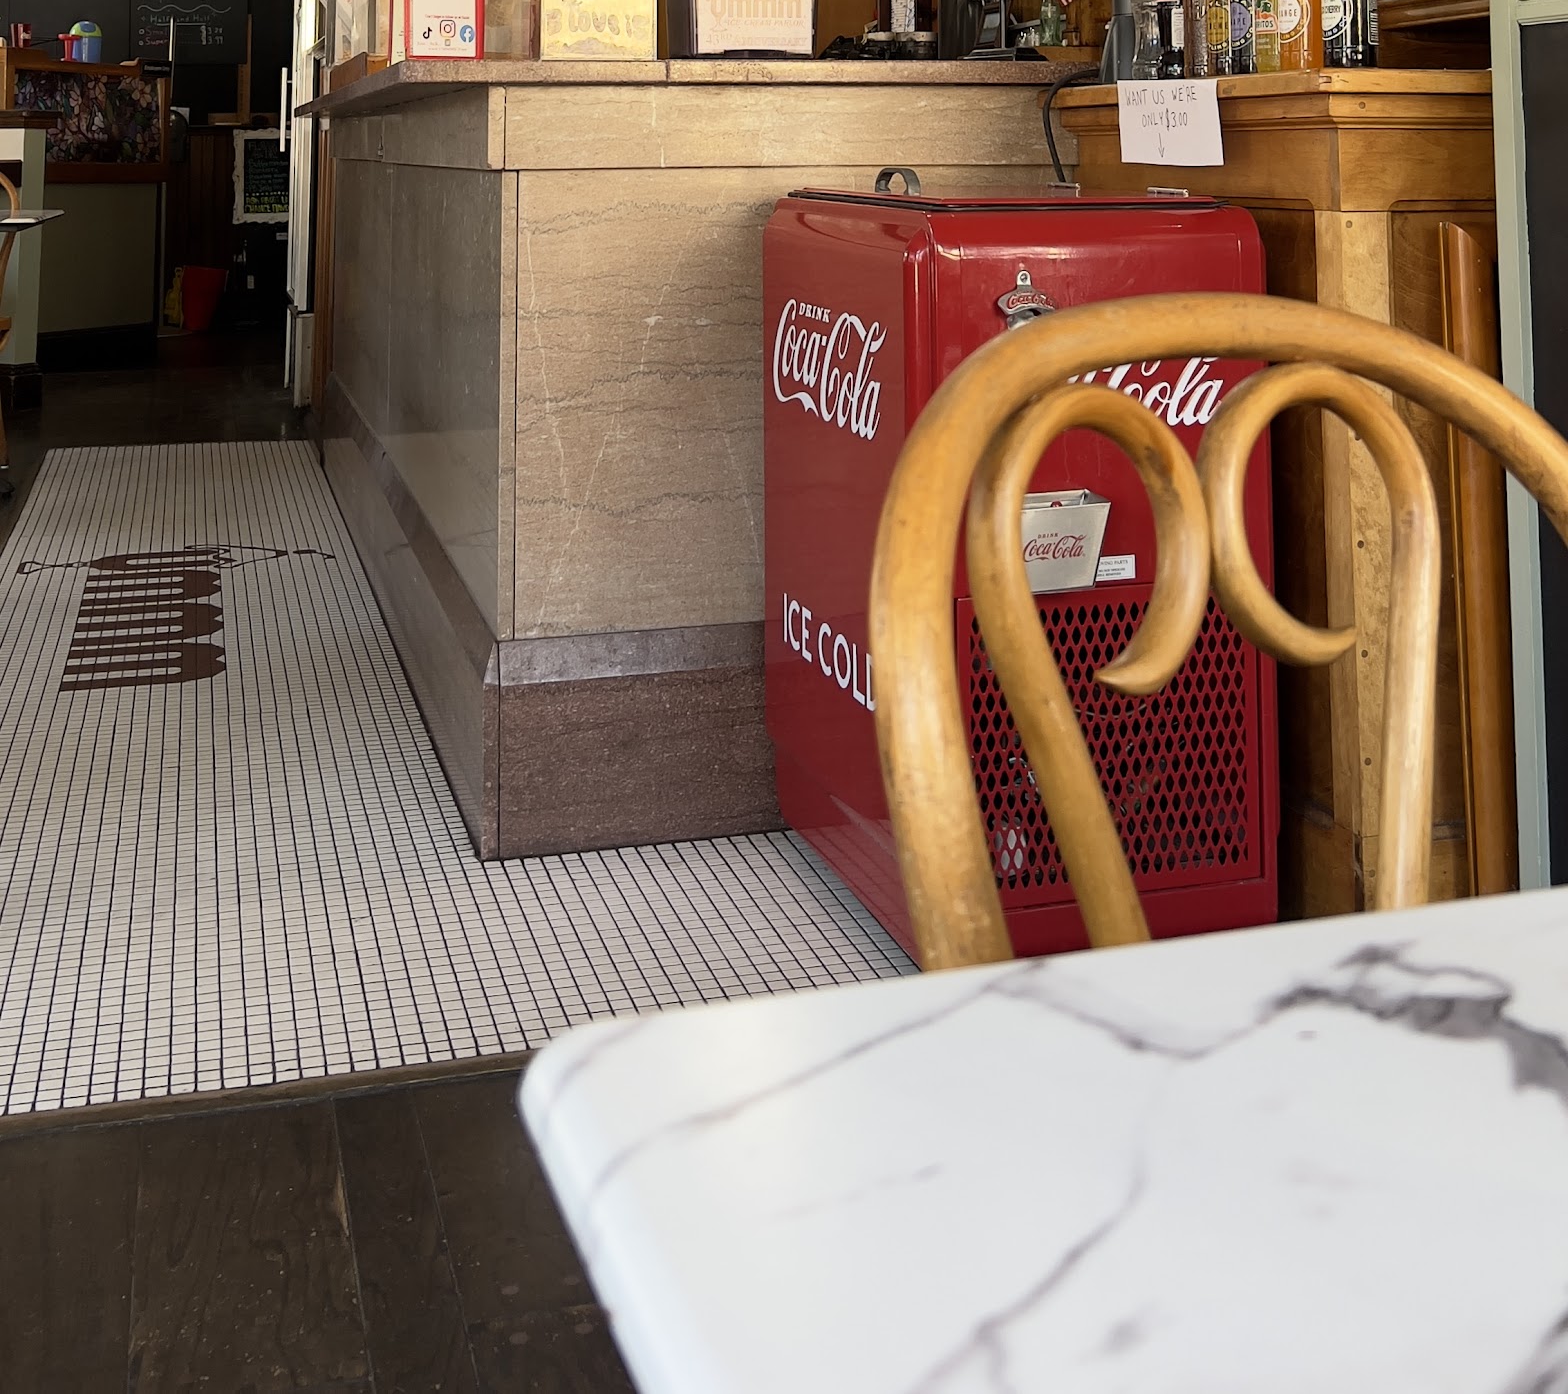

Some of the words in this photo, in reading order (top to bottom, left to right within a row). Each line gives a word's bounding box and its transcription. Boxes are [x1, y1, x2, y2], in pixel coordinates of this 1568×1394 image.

[1124, 87, 1148, 106] WANT
[1152, 89, 1165, 104] US
[1171, 84, 1198, 103] WE'RE
[1142, 111, 1164, 128] ONLY
[799, 303, 831, 323] DRINK
[773, 299, 887, 440] Coca-Cola
[1037, 532, 1059, 540] DRINK
[1023, 534, 1089, 563] Coca-Cola
[783, 592, 813, 663] ICE
